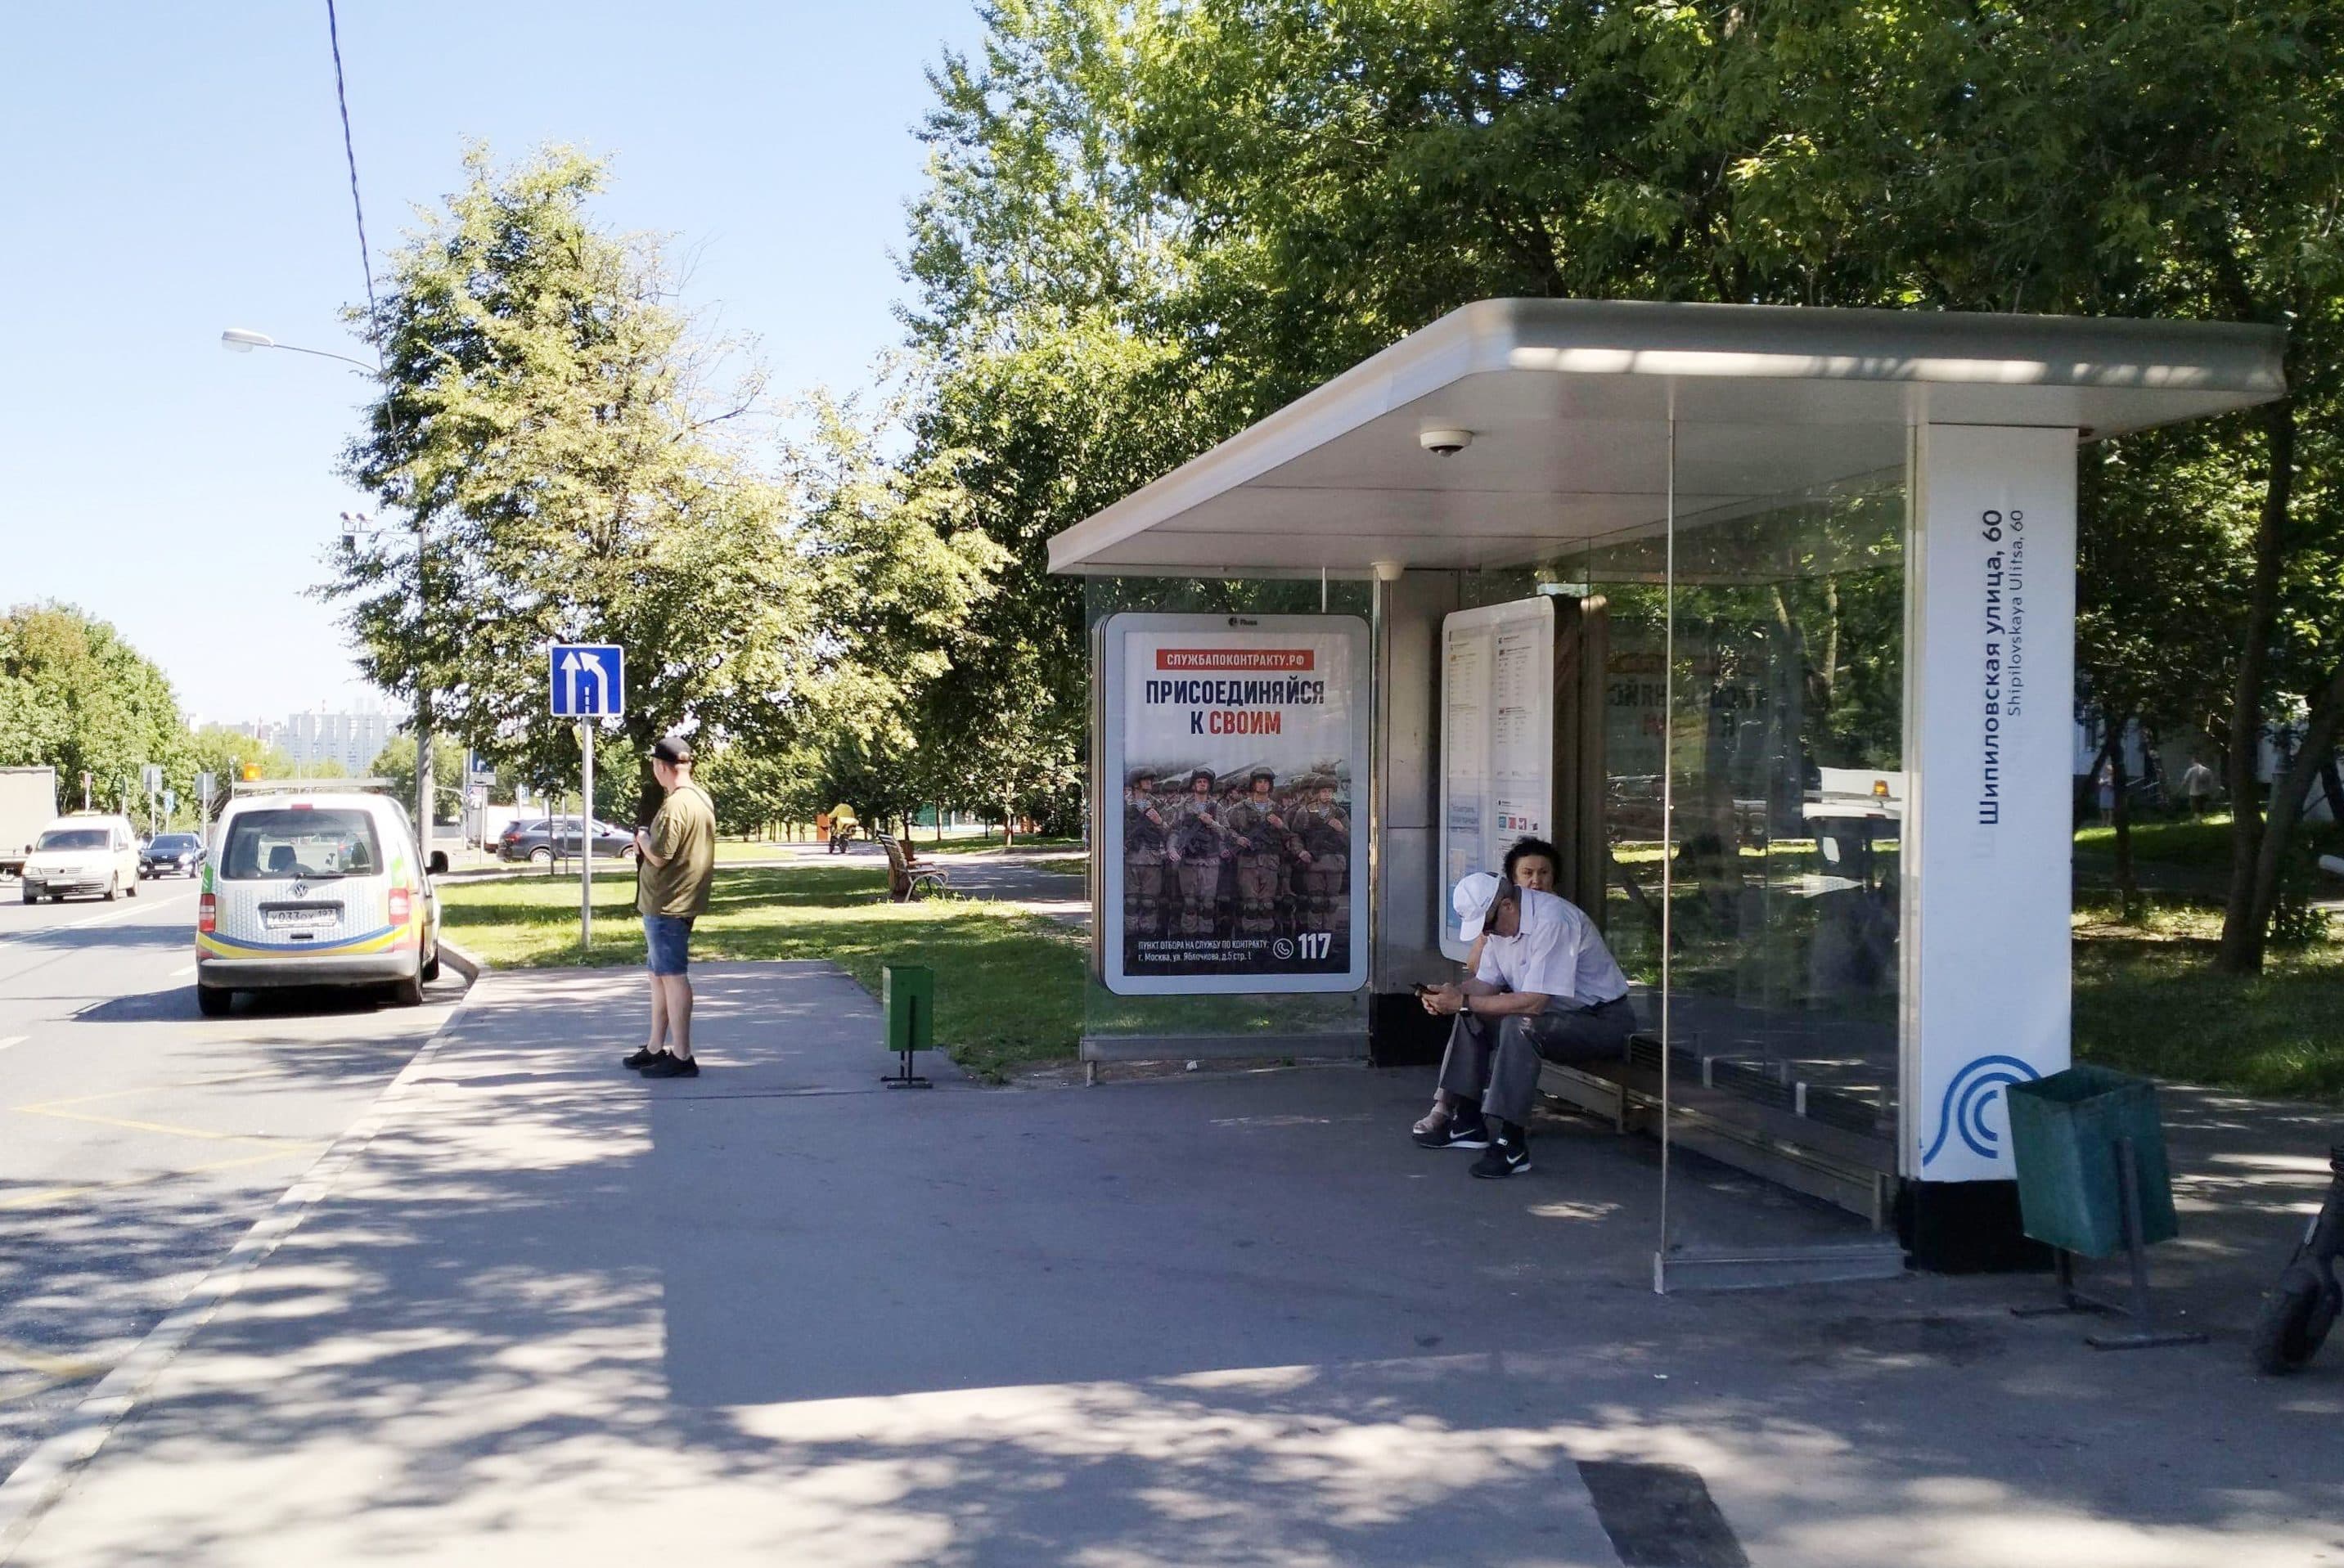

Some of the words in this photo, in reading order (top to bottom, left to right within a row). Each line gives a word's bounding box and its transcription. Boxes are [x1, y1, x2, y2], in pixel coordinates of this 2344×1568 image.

[1982, 509, 2004, 543] 60
[2009, 509, 2024, 532] 60
[2008, 537, 2025, 591] Ulitsa,
[1986, 550, 2006, 636] улица,
[1167, 654, 1305, 667] СЛУЖБАПОКОНТРАКТУ.РФ
[2007, 597, 2026, 717] Shipilovskaya
[1145, 676, 1325, 707] ПРИСОЕДИНЯЙСЯ
[1190, 711, 1204, 735] К
[1209, 711, 1282, 735] СВОИМ
[1979, 642, 2000, 825] Шипиловская
[1138, 941, 1159, 950] ПУНКТ
[1159, 941, 1185, 950] ОТБОРА
[1194, 940, 1221, 950] СЛУЖБУ
[1221, 940, 1231, 949] ПО
[1298, 932, 1332, 959] 117
